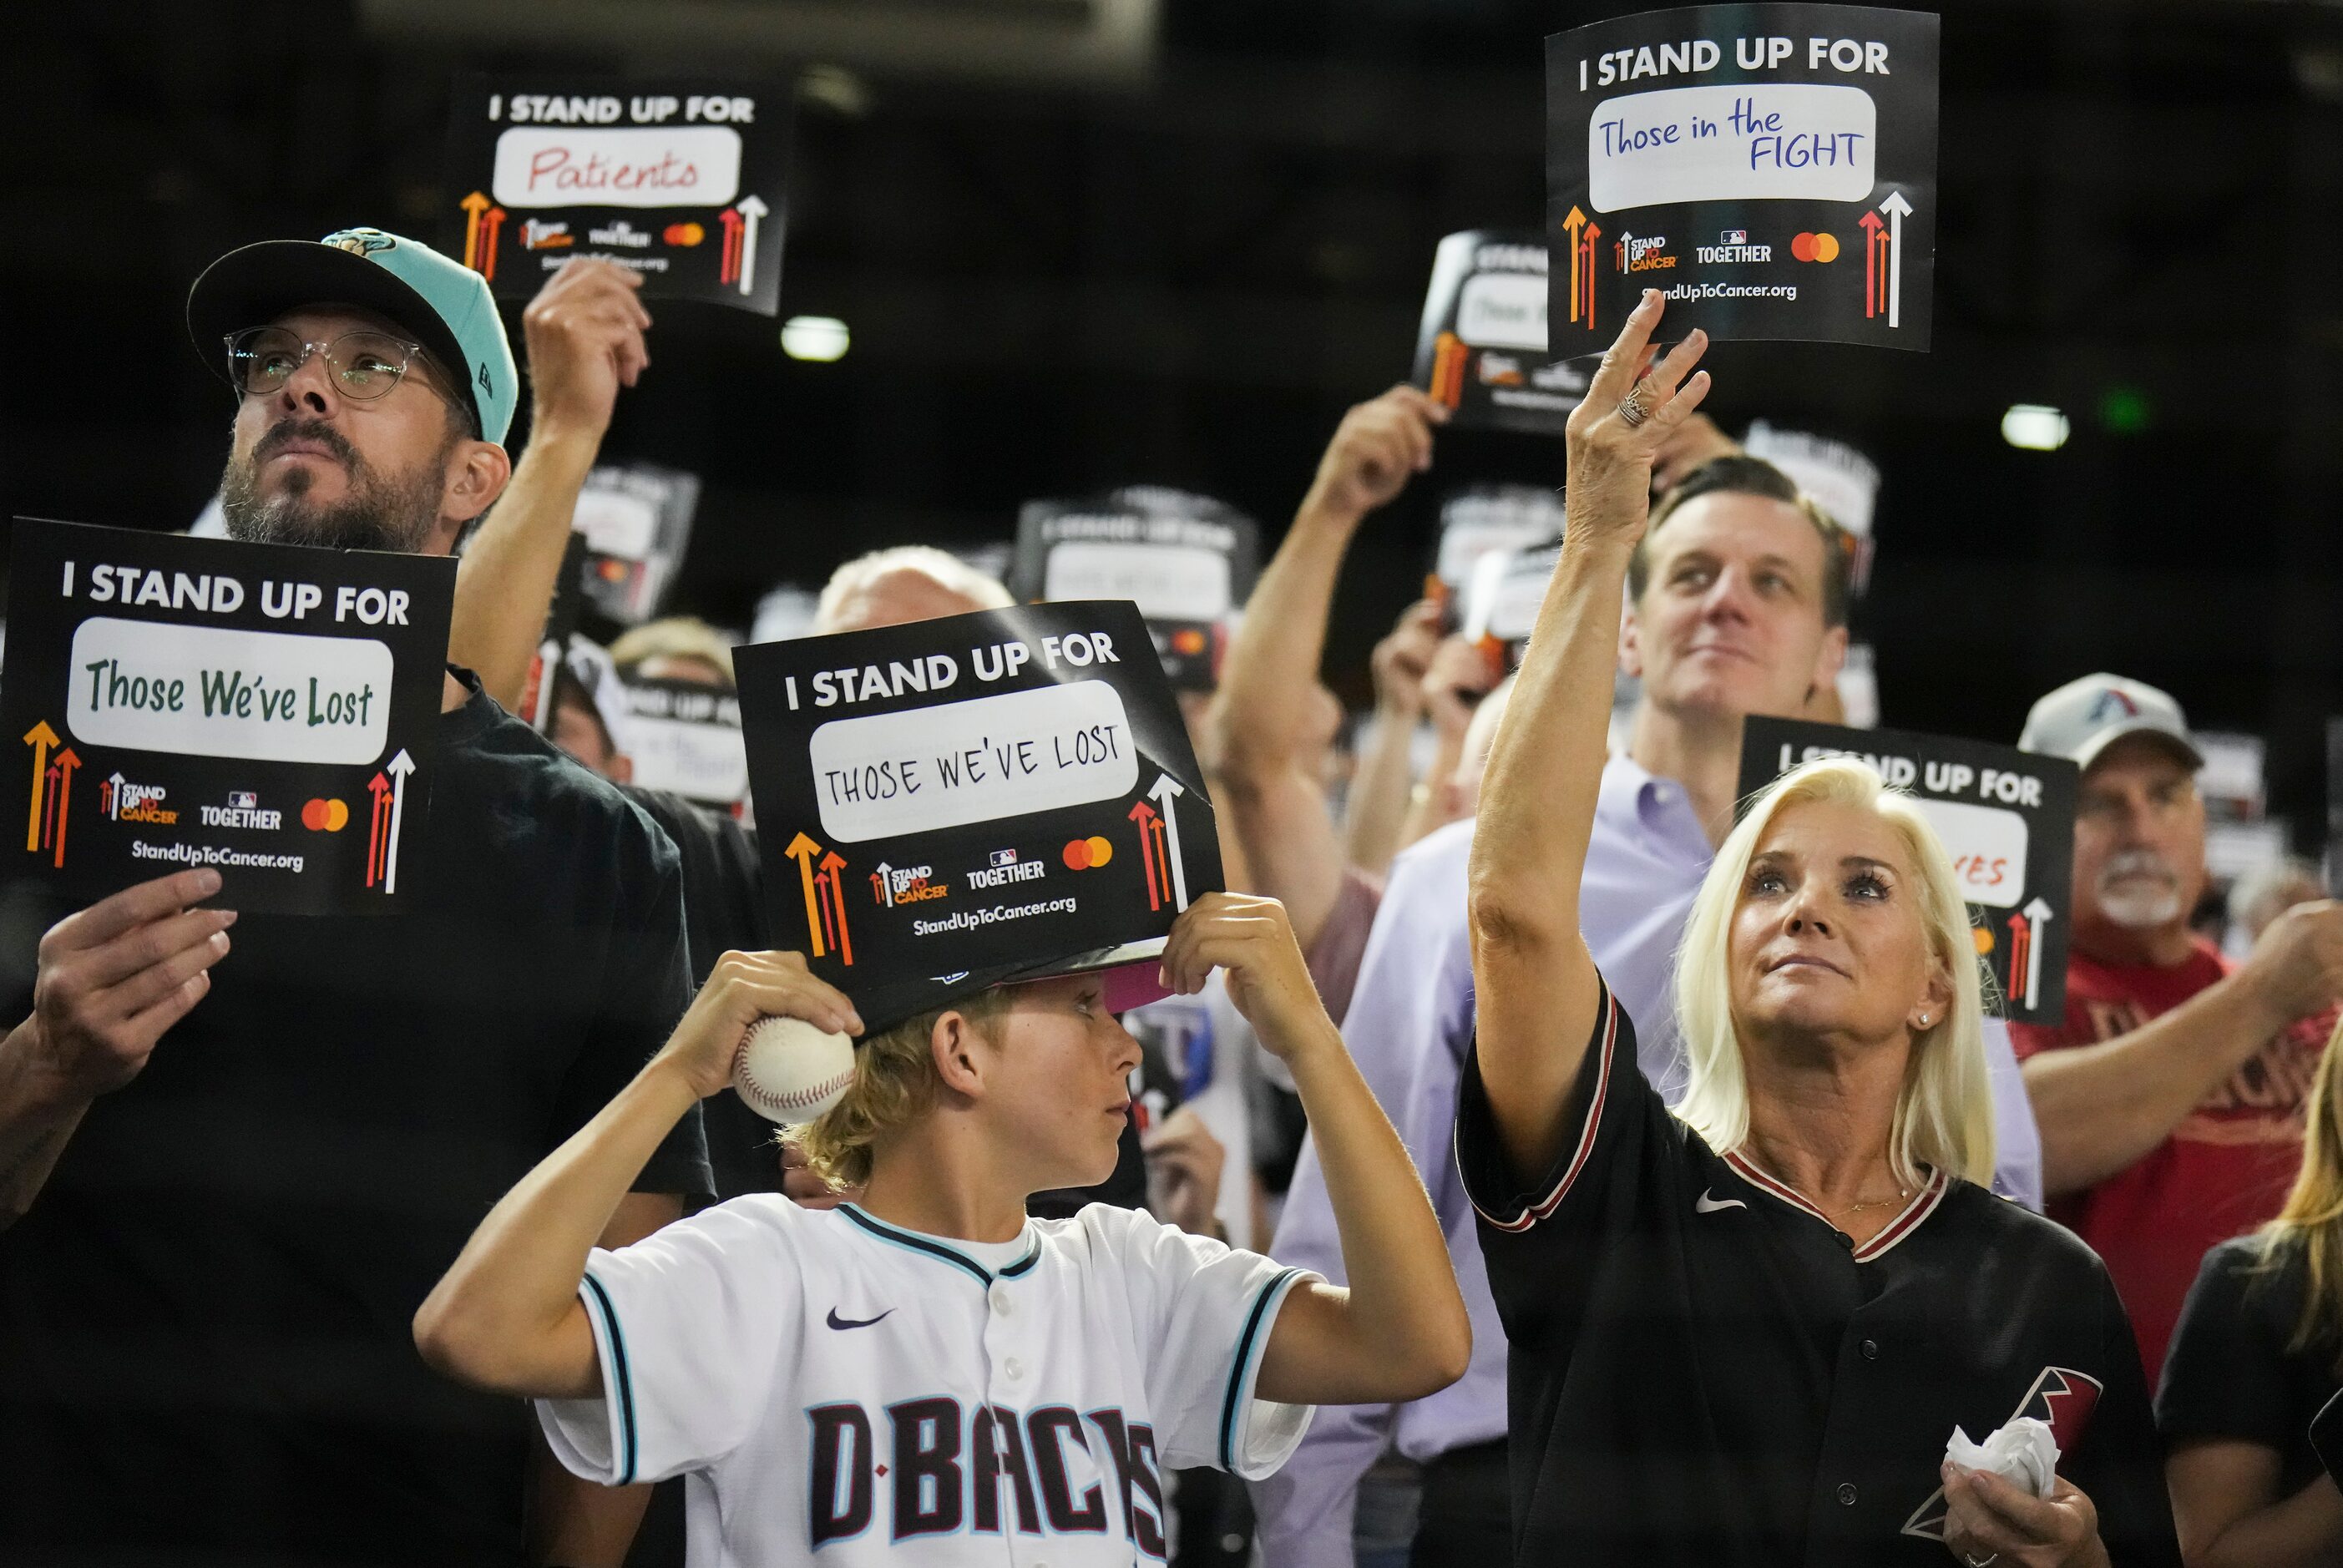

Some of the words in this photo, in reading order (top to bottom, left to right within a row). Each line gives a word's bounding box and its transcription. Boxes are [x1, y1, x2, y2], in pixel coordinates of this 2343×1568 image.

[1580, 60, 1586, 91] I
[1597, 40, 1720, 86] STAND
[1736, 38, 1794, 69] UP
[1809, 38, 1890, 75] FOR
[488, 95, 502, 121] I
[509, 95, 621, 124] STAND
[630, 96, 679, 122] UP
[686, 96, 755, 124] FOR
[1600, 119, 1680, 158] Those
[1692, 116, 1717, 139] in
[1728, 98, 1784, 137] the
[1750, 133, 1865, 170] FIGHT
[528, 147, 699, 192] Patients
[1631, 236, 1666, 251] STAND
[1631, 250, 1645, 261] UP
[1645, 248, 1660, 260] TO
[1696, 245, 1772, 264] TOGETHER
[1630, 256, 1677, 271] CANCER
[1642, 282, 1797, 302] ndUpToCancer.org
[62, 561, 74, 597] I
[89, 564, 244, 614] STAND
[261, 581, 322, 620] UP
[335, 587, 409, 625] FOR
[785, 675, 800, 711] I
[814, 654, 959, 708] STAND
[972, 641, 1030, 683] UP
[1040, 631, 1121, 670] FOR
[86, 659, 184, 712] Those
[200, 670, 296, 722] We've
[307, 677, 373, 726] Lost
[825, 761, 922, 807] THOSE
[936, 736, 1038, 789] WE'VE
[1055, 724, 1120, 769] LOST
[1779, 743, 1792, 773] I
[1925, 761, 1974, 794] UP
[1980, 768, 2044, 808] FOR
[122, 795, 140, 809] UP
[123, 783, 166, 800] STAND
[120, 808, 177, 824] CANCER
[200, 806, 281, 830] TOGETHER
[131, 840, 304, 873] StandUpToCancer.org
[891, 865, 933, 883] STAND
[893, 879, 911, 893] UP
[967, 860, 1045, 890] TOGETHER
[894, 885, 948, 904] CANCER
[913, 898, 1076, 936] StandUpToCancer.org
